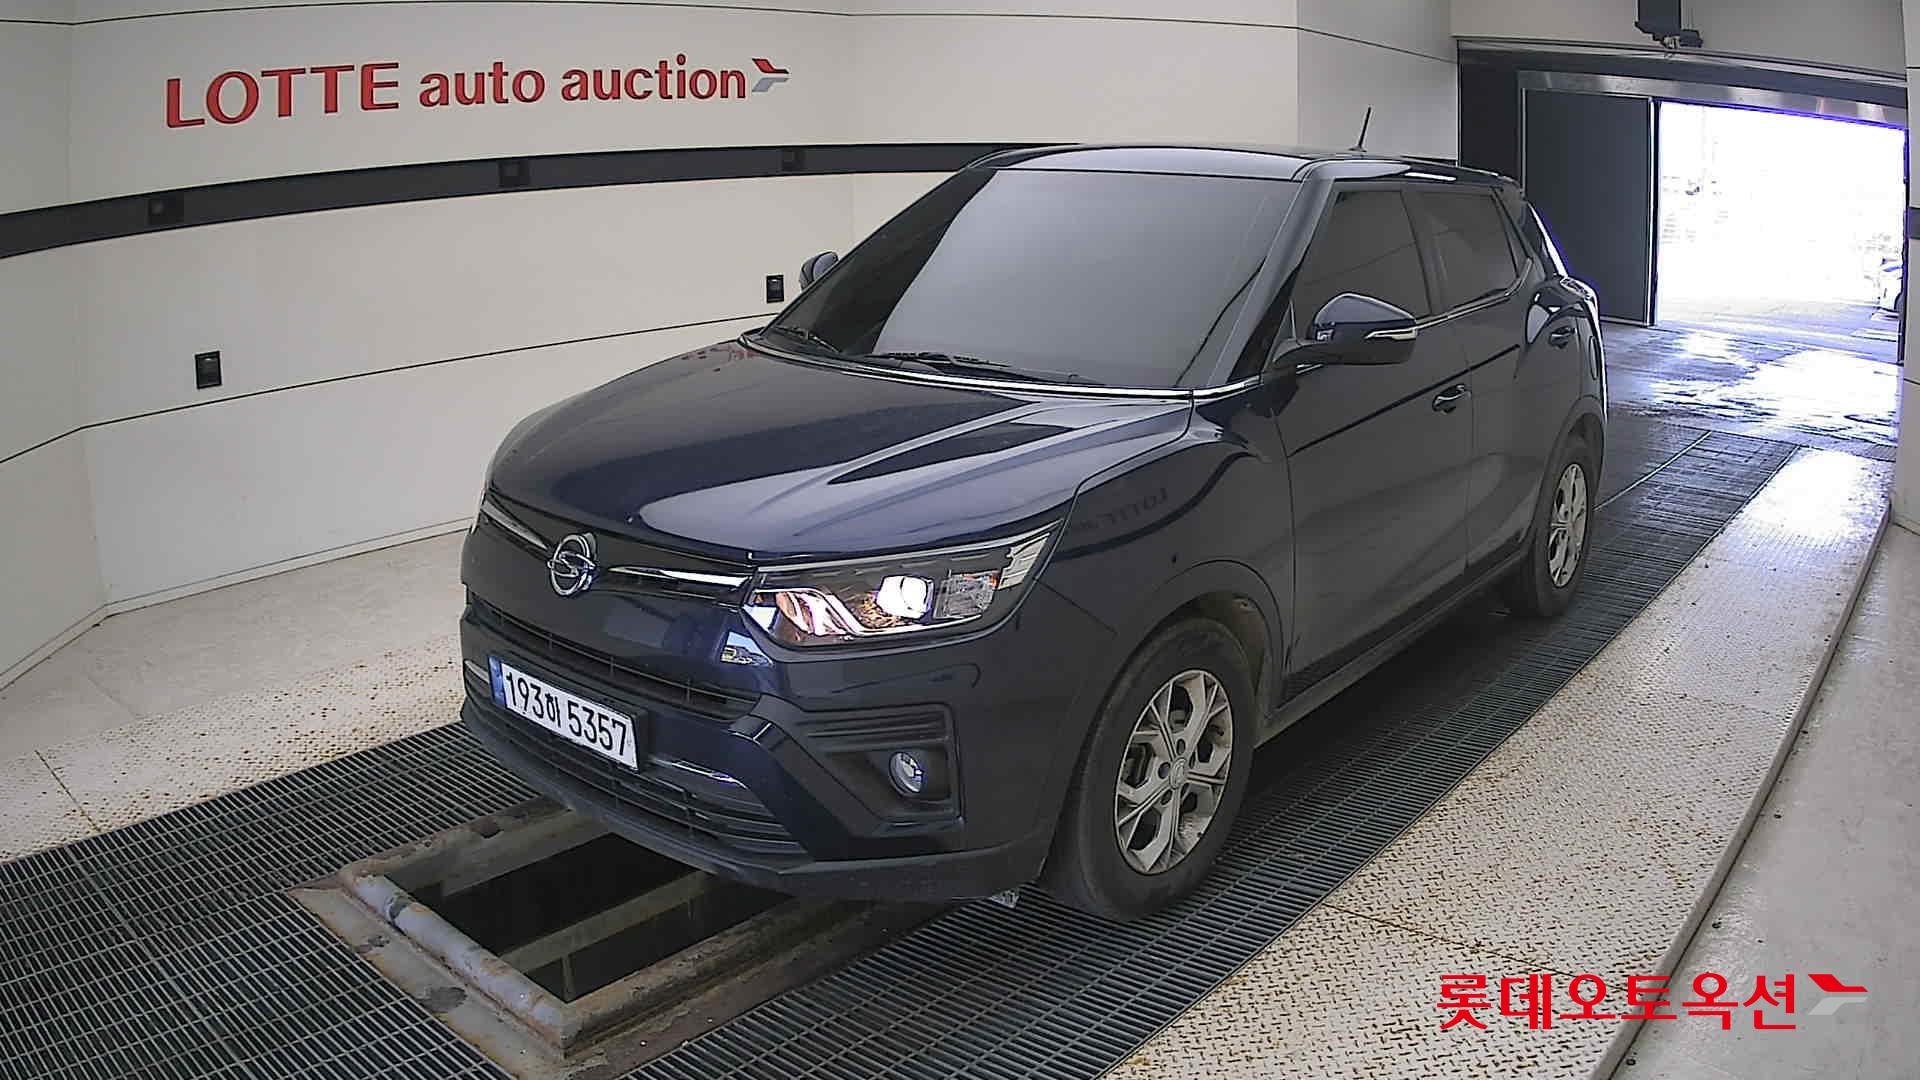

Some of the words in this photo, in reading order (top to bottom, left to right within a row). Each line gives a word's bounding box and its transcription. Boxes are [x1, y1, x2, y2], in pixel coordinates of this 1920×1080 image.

[166, 62, 399, 128] LOTTE
[419, 61, 546, 108] auto
[561, 54, 747, 101] auction
[567, 699, 626, 756] 5357
